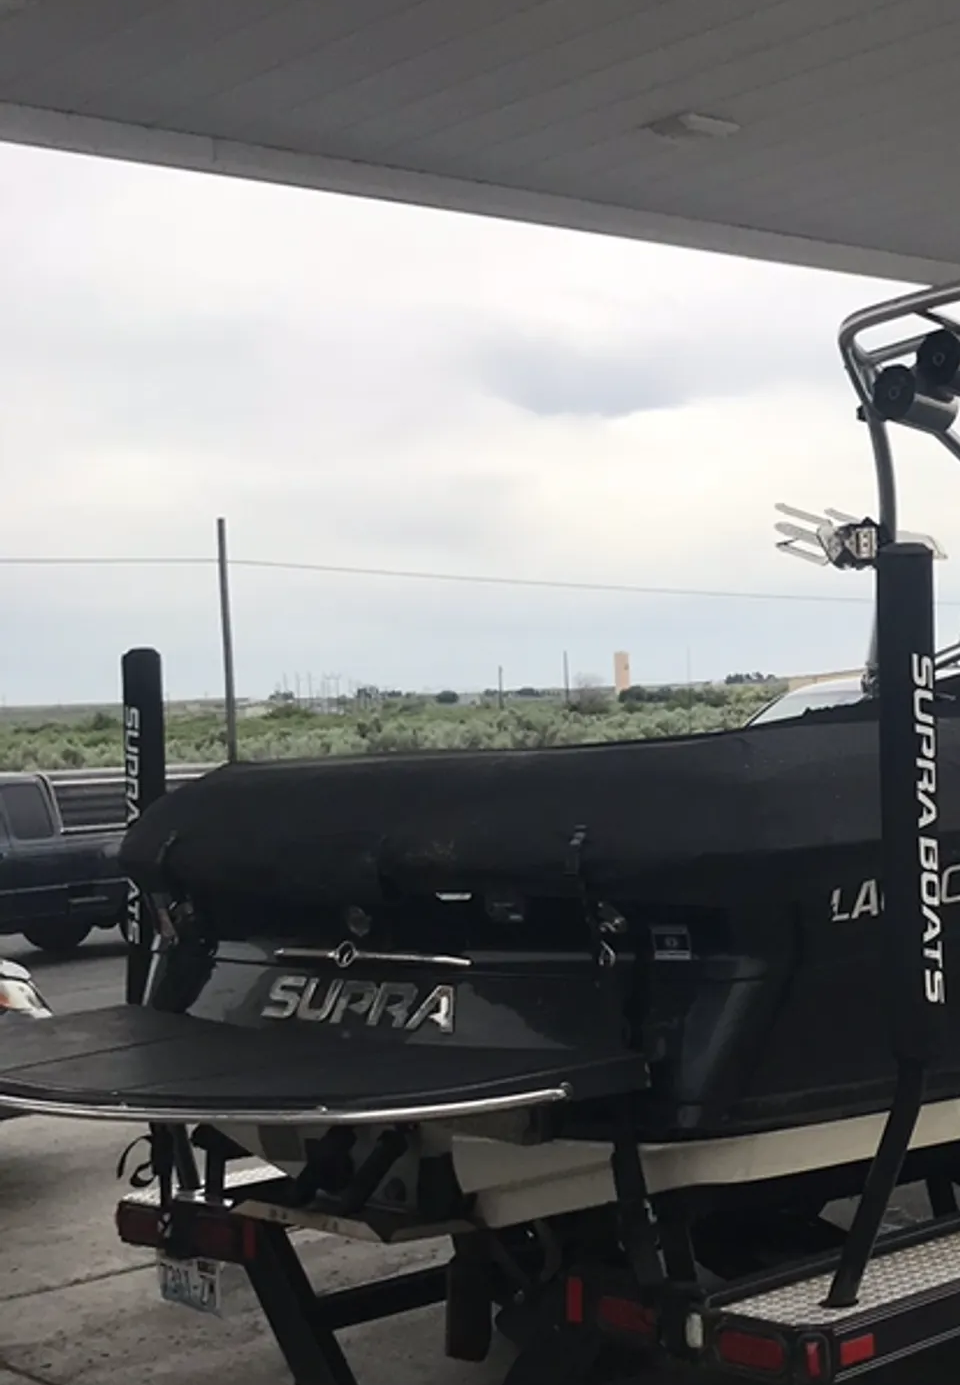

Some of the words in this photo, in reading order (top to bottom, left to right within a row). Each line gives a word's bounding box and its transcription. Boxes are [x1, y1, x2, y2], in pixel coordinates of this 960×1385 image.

[125, 705, 142, 827] SUPRA
[911, 652, 937, 829] SUPRA
[127, 877, 142, 945] ATS
[918, 836, 946, 1004] BOATS
[259, 975, 455, 1033] SUPRA
